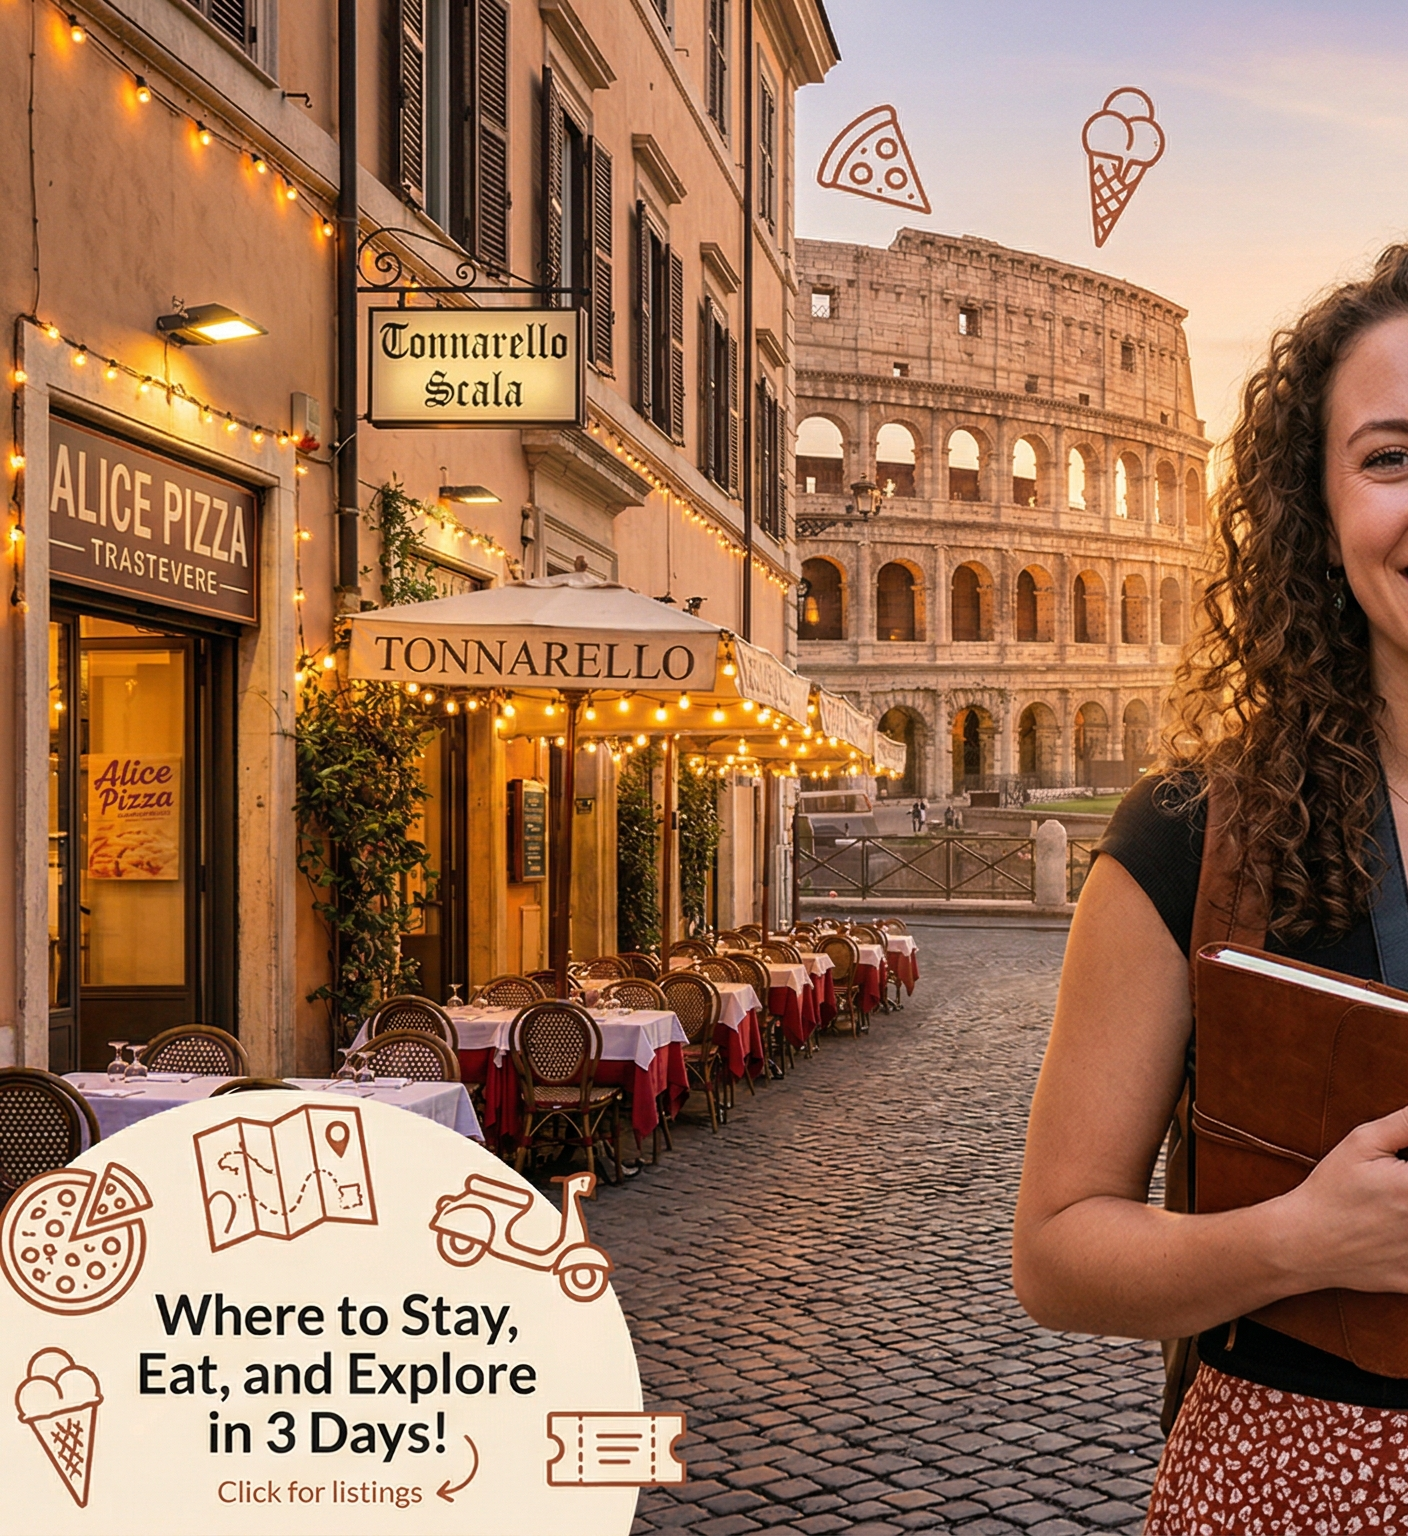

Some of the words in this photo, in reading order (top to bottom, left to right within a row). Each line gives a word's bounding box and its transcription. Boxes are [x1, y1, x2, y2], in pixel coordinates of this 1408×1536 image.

[379, 322, 568, 360] Tonnarello
[424, 370, 524, 408] Scala
[50, 443, 152, 540] ALICE
[164, 480, 249, 568] PIZZA
[91, 537, 218, 595] TRASTEVERE
[375, 636, 695, 681] TONNARELLO
[94, 759, 173, 791] Alice
[99, 787, 175, 816] Pizza
